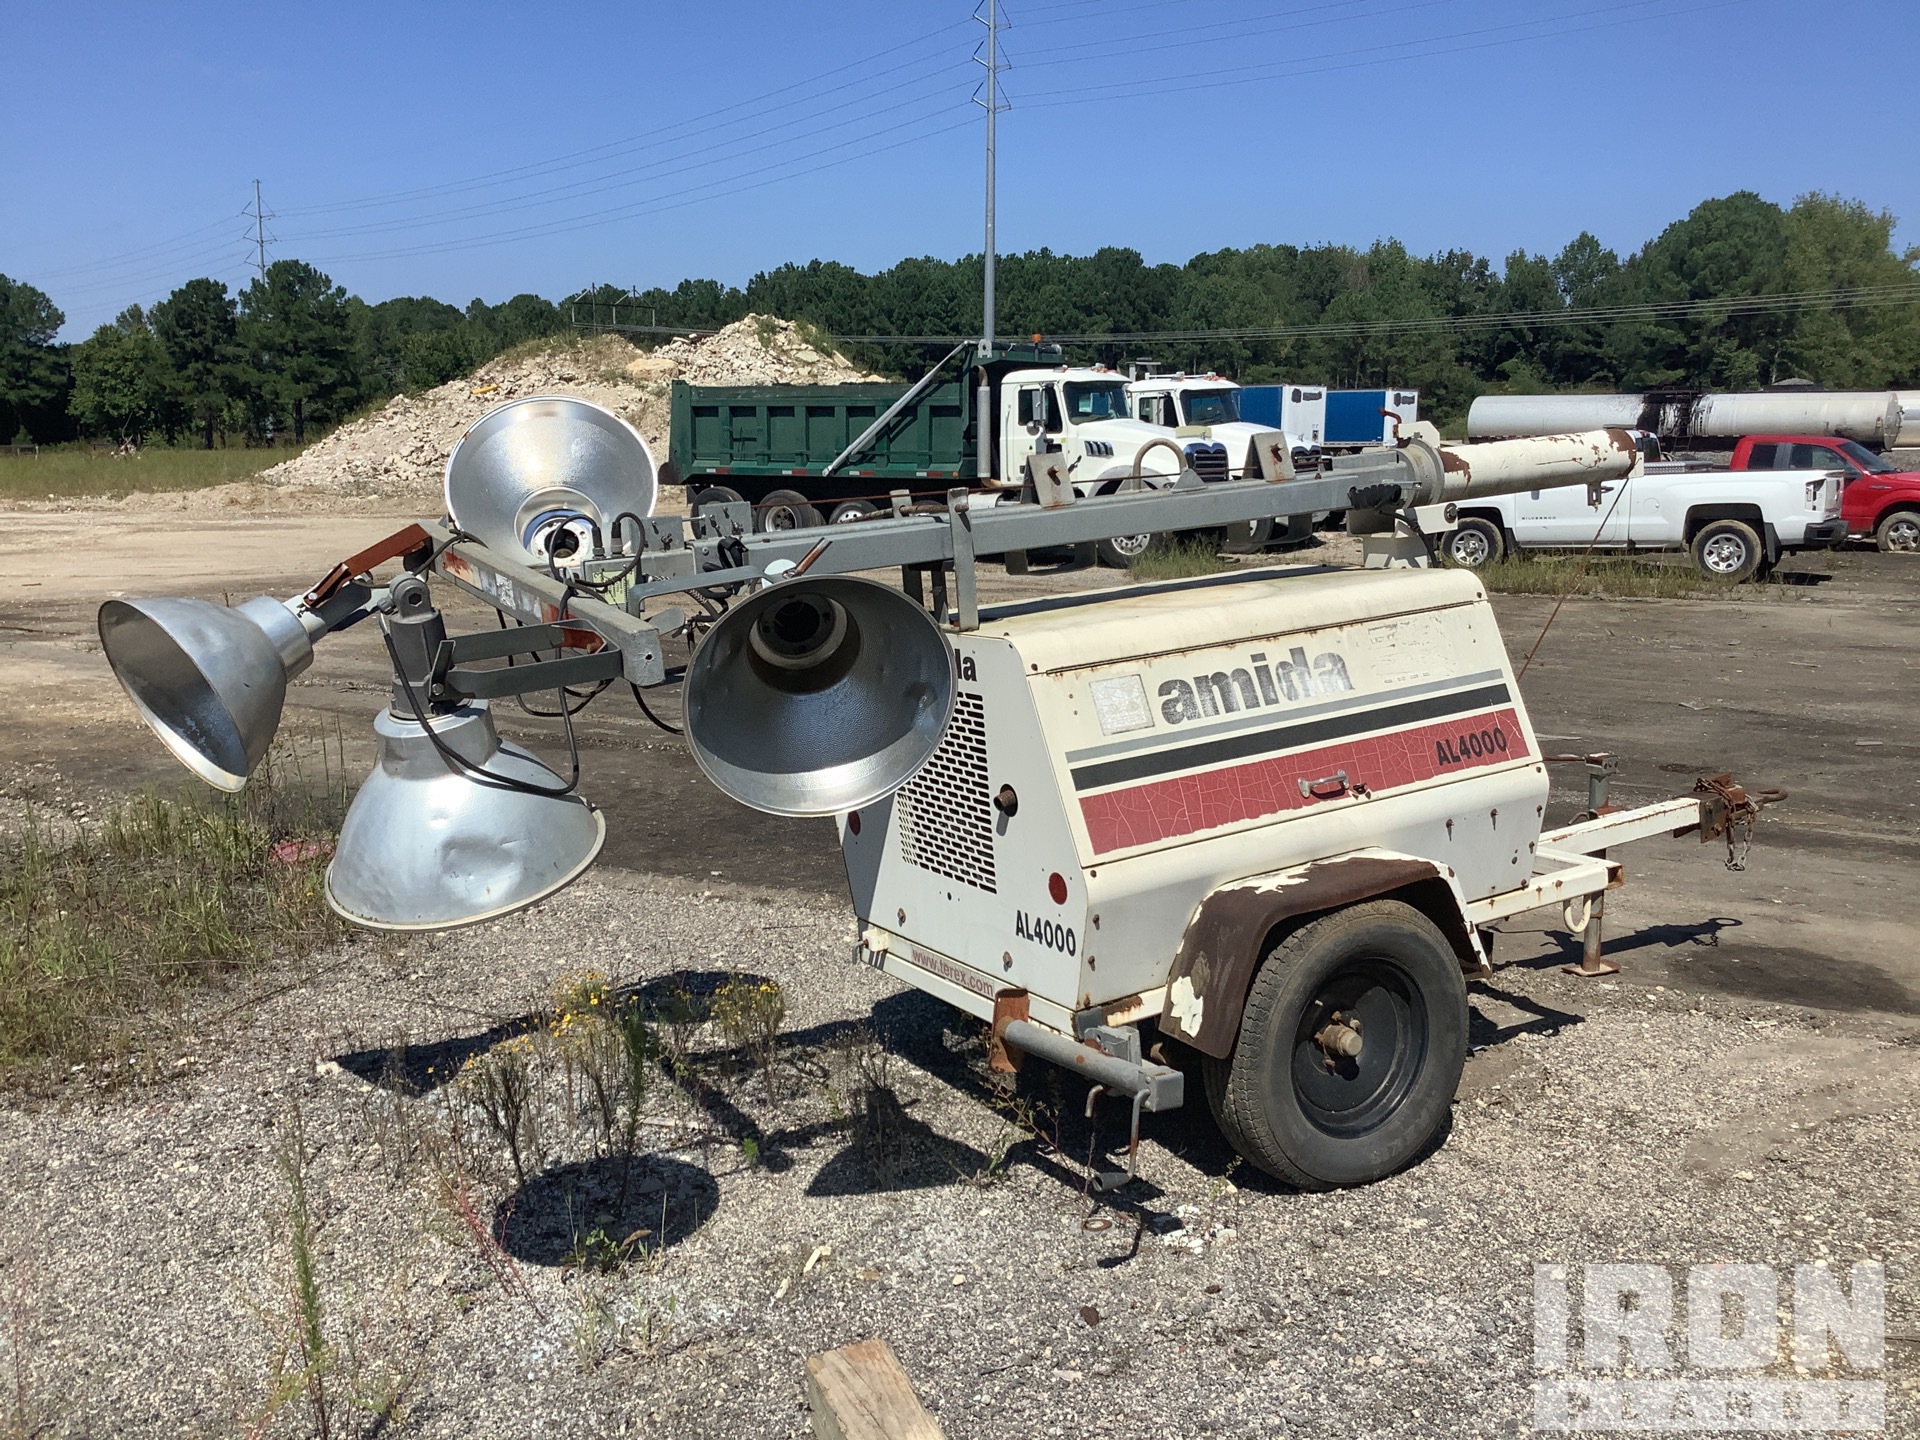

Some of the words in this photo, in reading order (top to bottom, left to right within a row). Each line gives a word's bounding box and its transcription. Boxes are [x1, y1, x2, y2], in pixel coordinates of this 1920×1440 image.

[1158, 646, 1355, 725] amida
[1435, 727, 1507, 766] AL4000
[1015, 909, 1077, 957] AL4000
[912, 949, 994, 998] www.terex.com
